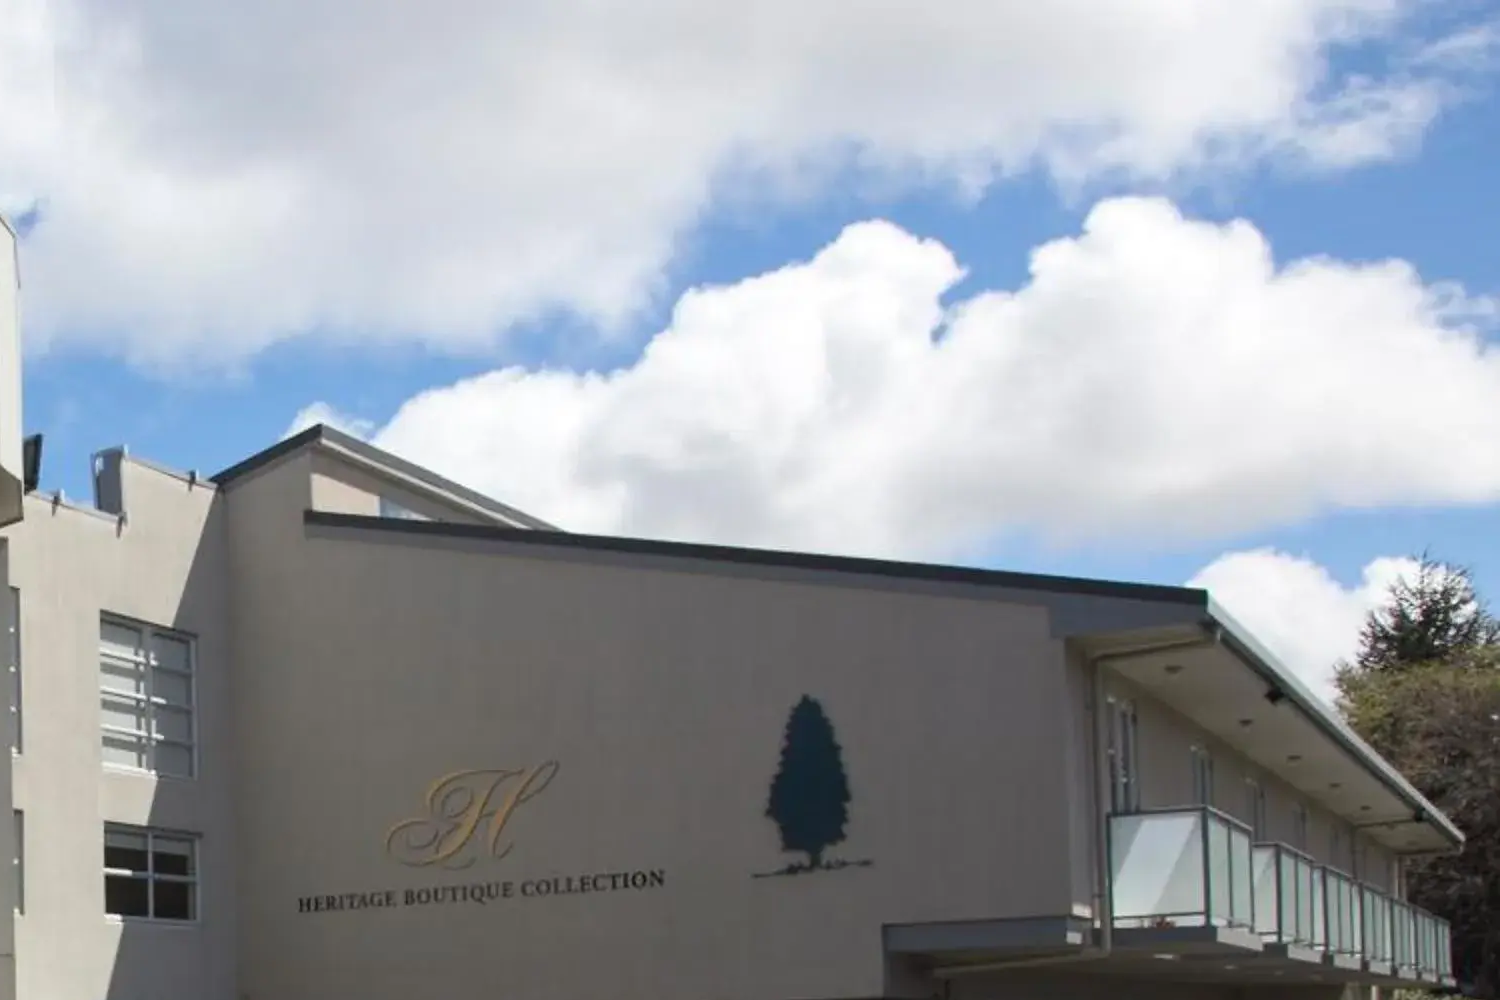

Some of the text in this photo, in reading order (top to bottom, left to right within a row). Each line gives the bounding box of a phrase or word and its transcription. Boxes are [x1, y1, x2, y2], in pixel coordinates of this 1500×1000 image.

[298, 869, 665, 914] HERITAGE BOUTIQUE COLLECTION
